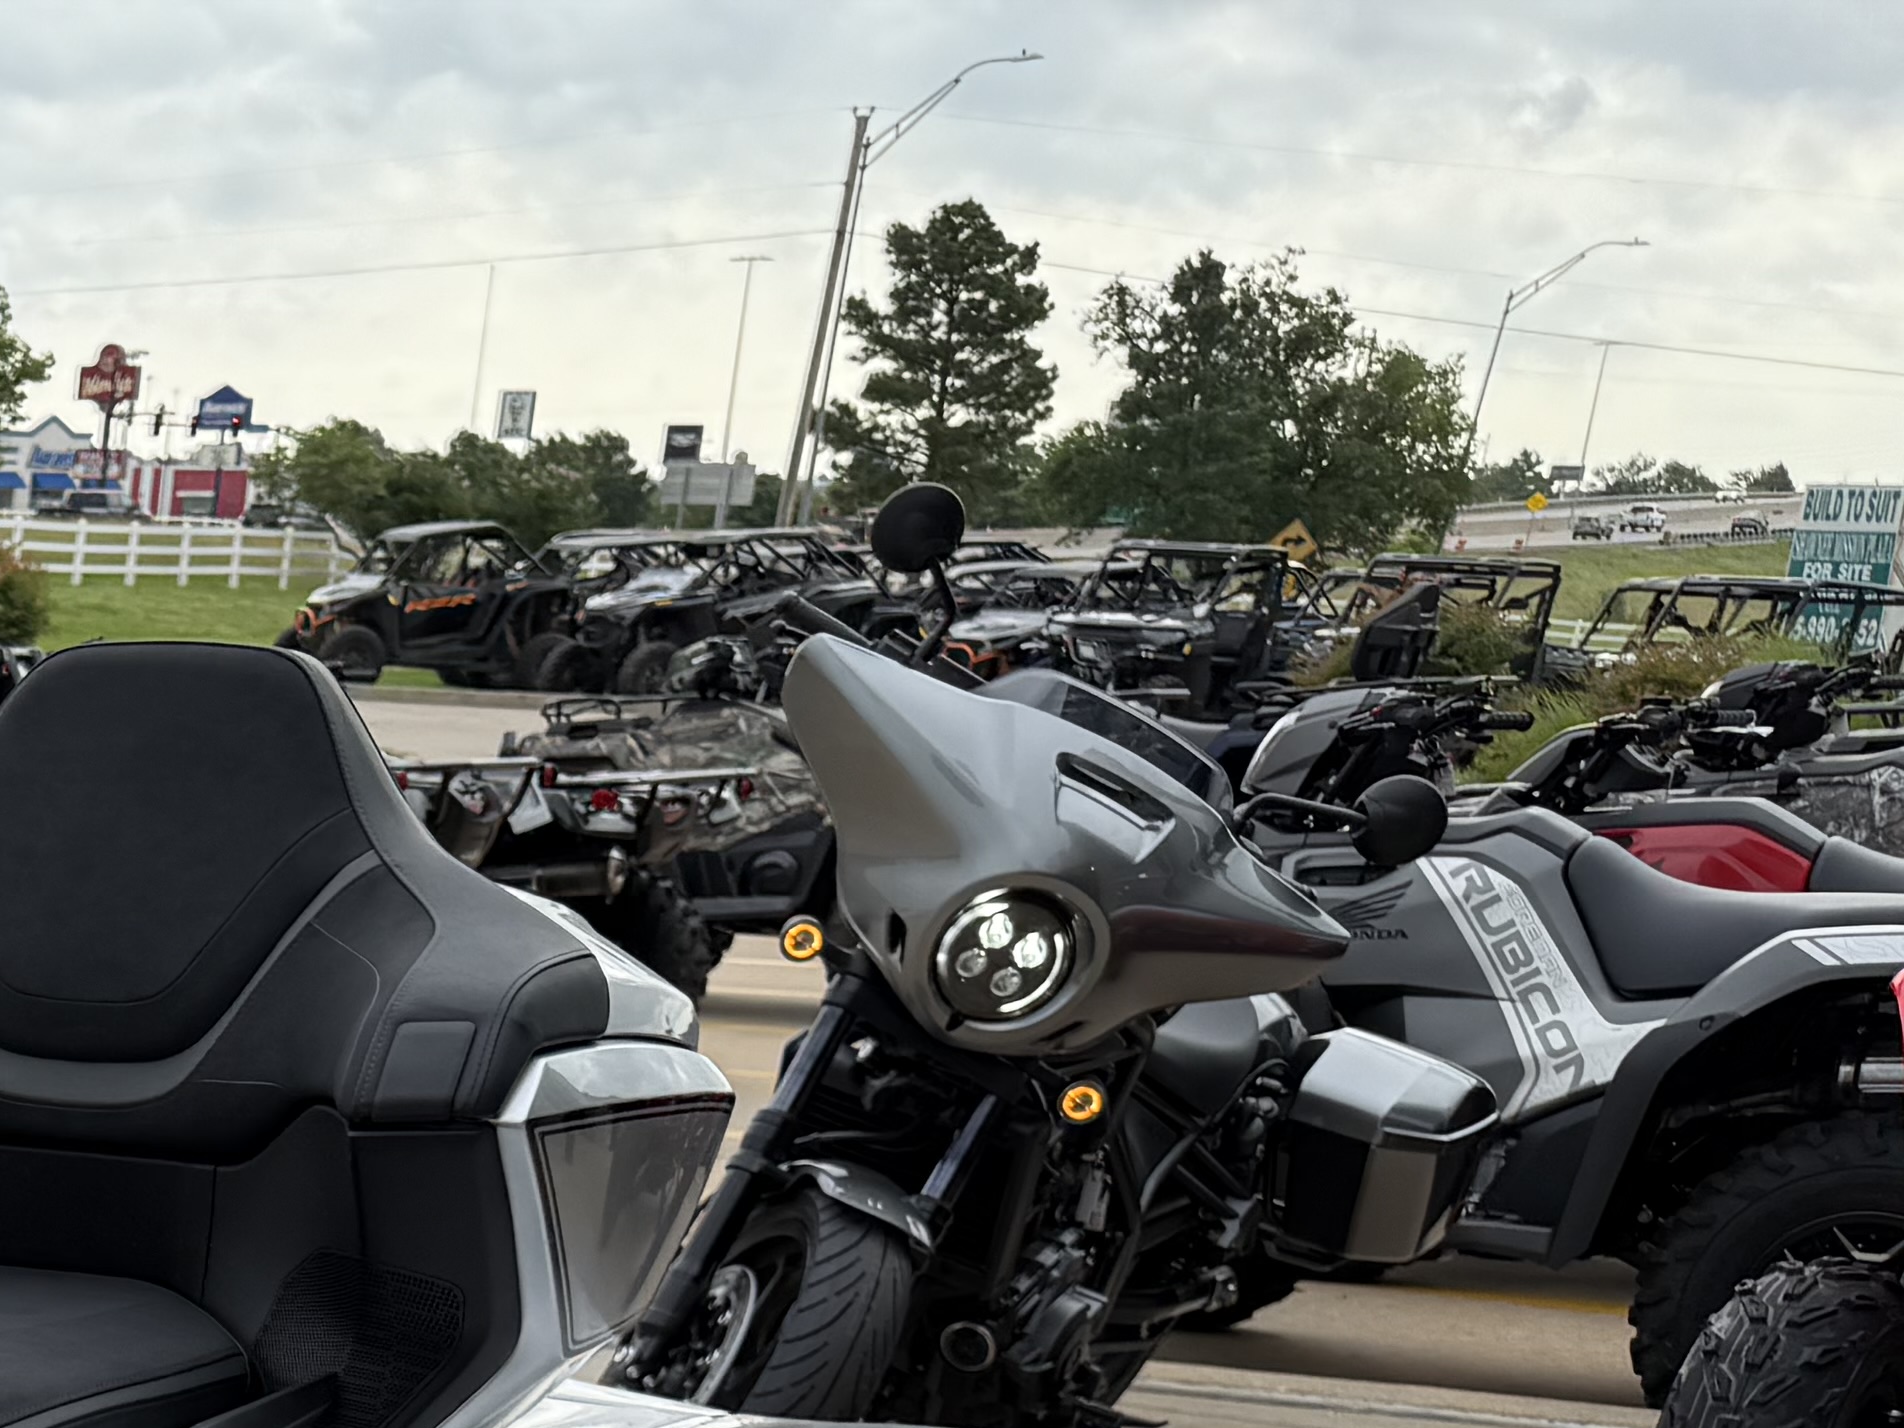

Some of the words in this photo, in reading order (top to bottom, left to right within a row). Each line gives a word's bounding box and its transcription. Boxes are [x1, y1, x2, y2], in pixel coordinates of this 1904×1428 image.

[1803, 488, 1844, 521] BUILD
[1846, 489, 1867, 522] TO
[1865, 489, 1902, 524] SUIT
[1802, 561, 1833, 583] FOR
[1837, 563, 1873, 582] SITE
[1351, 928, 1409, 941] ONDA
